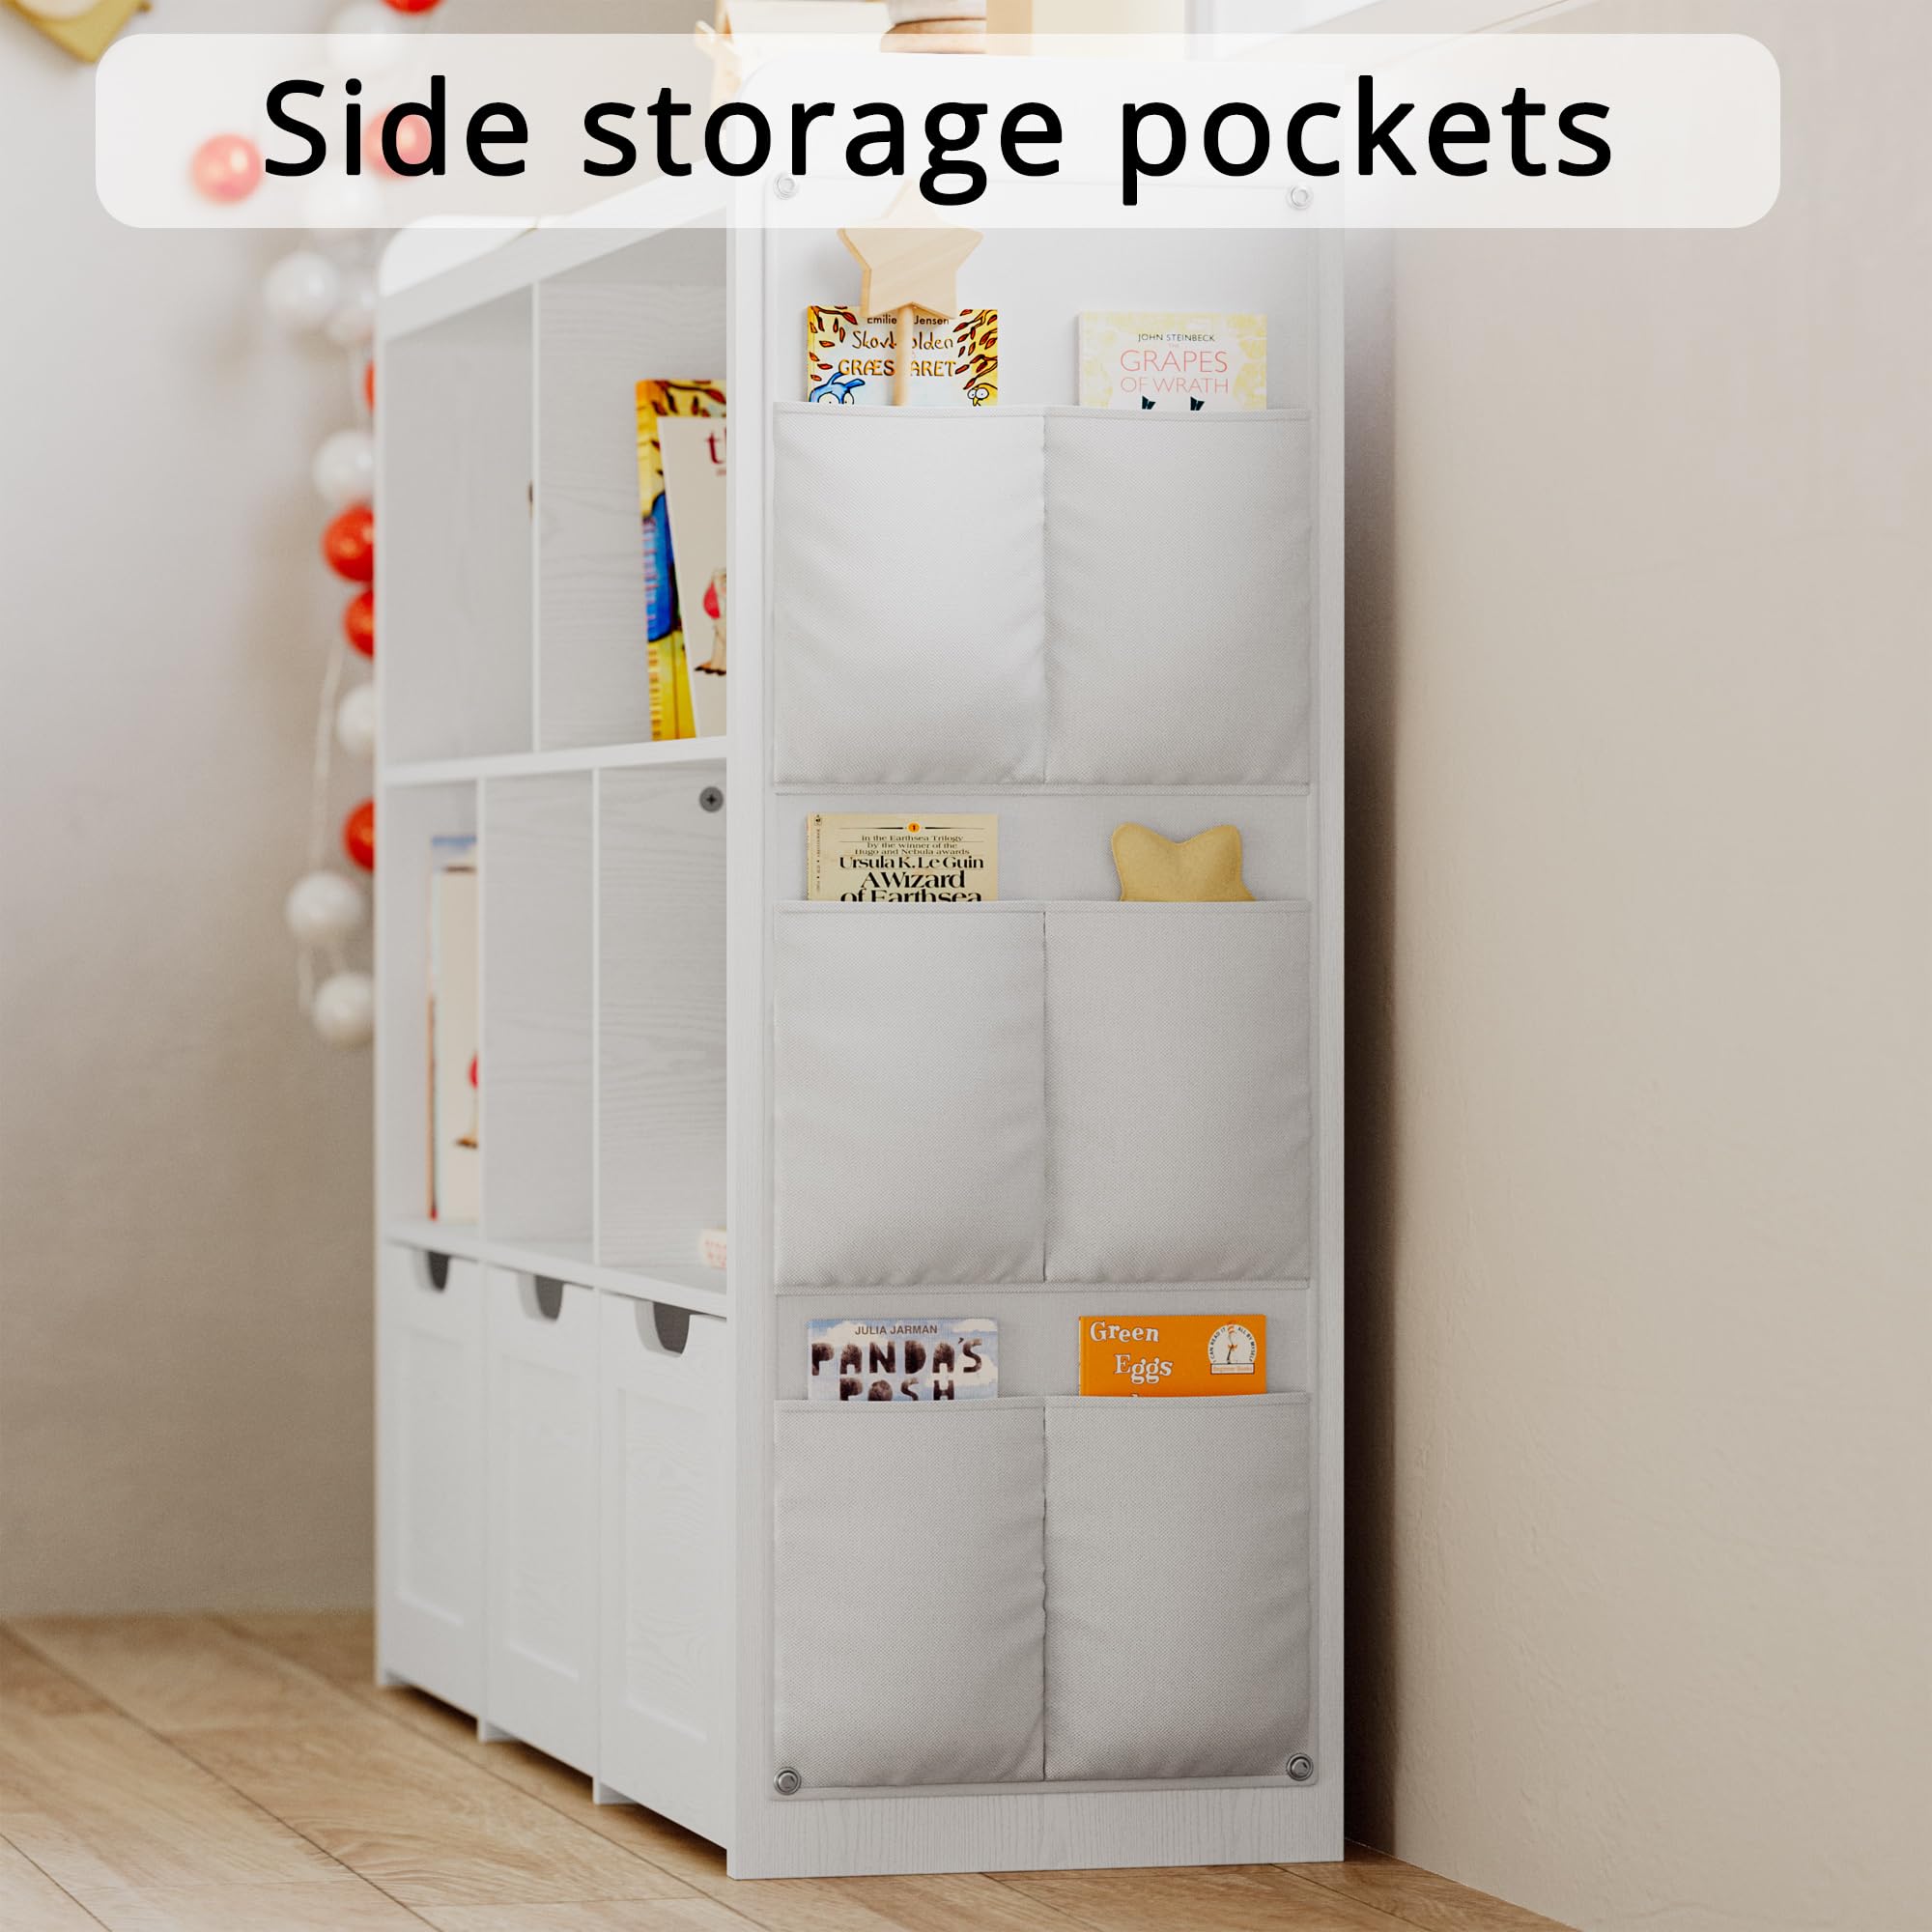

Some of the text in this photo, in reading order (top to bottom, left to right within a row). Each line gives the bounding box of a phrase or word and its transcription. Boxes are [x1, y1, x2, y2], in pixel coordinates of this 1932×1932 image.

[914, 315, 949, 325] Jensen
[1138, 333, 1215, 342] JOHN STEINBECK
[1121, 349, 1228, 373] GRAPES
[1121, 377, 1229, 394] OF WRATH
[839, 856, 984, 868] Ursula K. Le Guin
[861, 869, 965, 889] A Wizard
[840, 888, 981, 901] of Earthsea
[855, 1324, 938, 1335] JULIA JARMAN
[1090, 1321, 1159, 1343] Green
[811, 1337, 982, 1376] PANDA'S
[1114, 1353, 1174, 1384] Eggs
[839, 1378, 954, 1401] POSH
